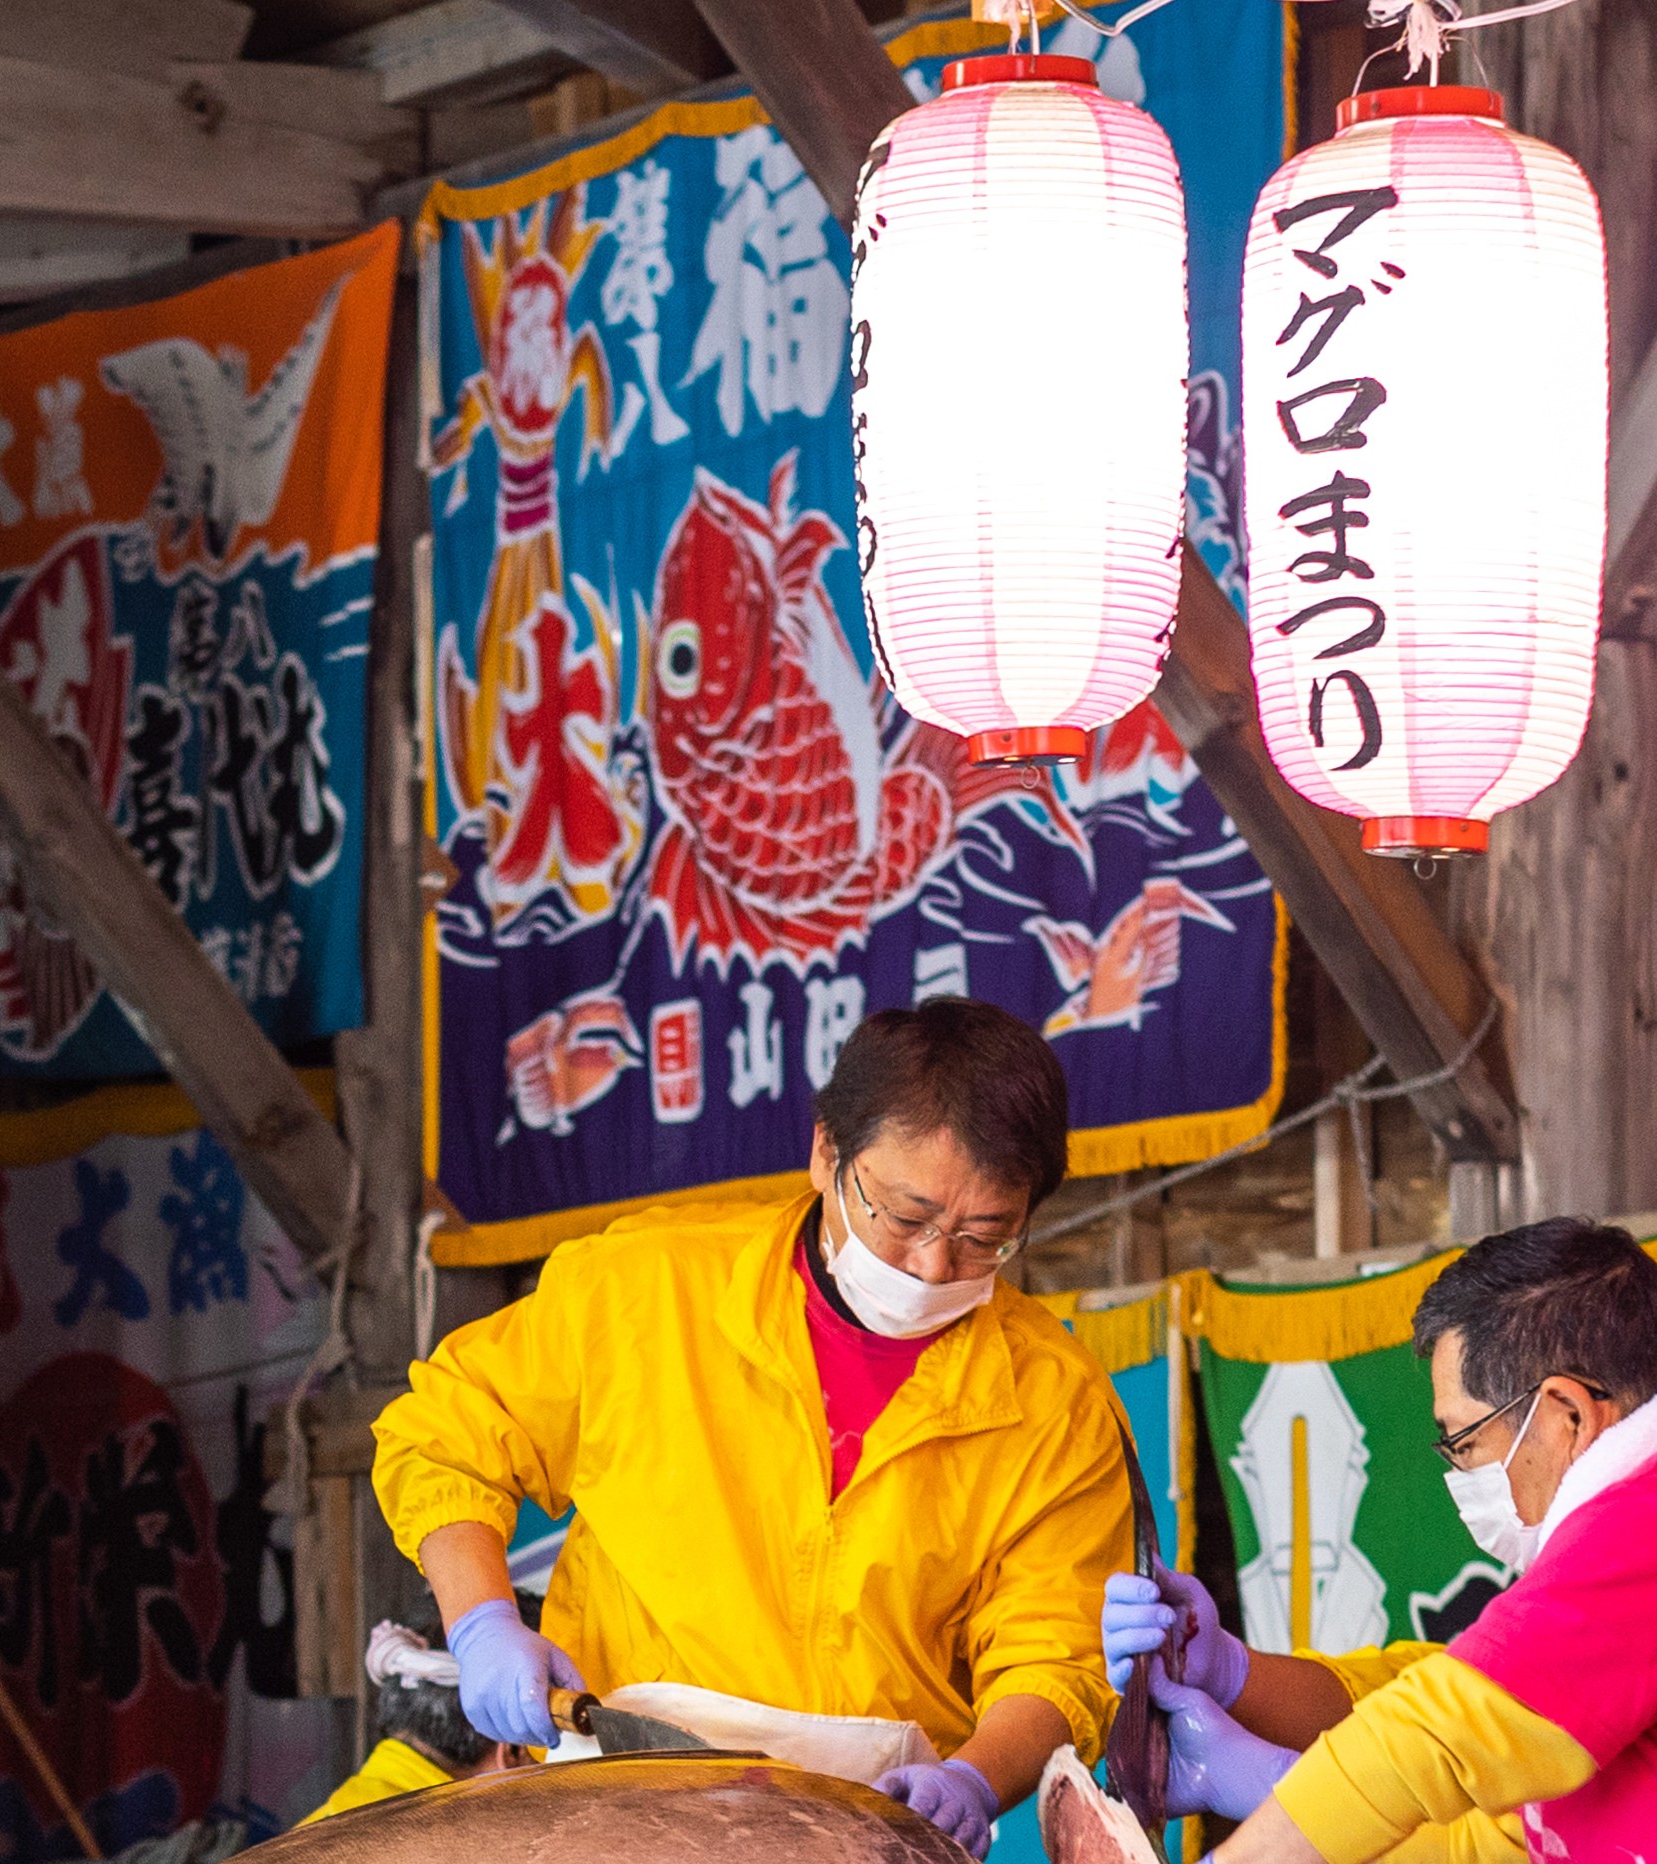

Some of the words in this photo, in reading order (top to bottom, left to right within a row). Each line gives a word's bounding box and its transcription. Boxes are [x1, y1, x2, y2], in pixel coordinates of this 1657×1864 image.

[1274, 185, 1409, 773] マグロまつり
